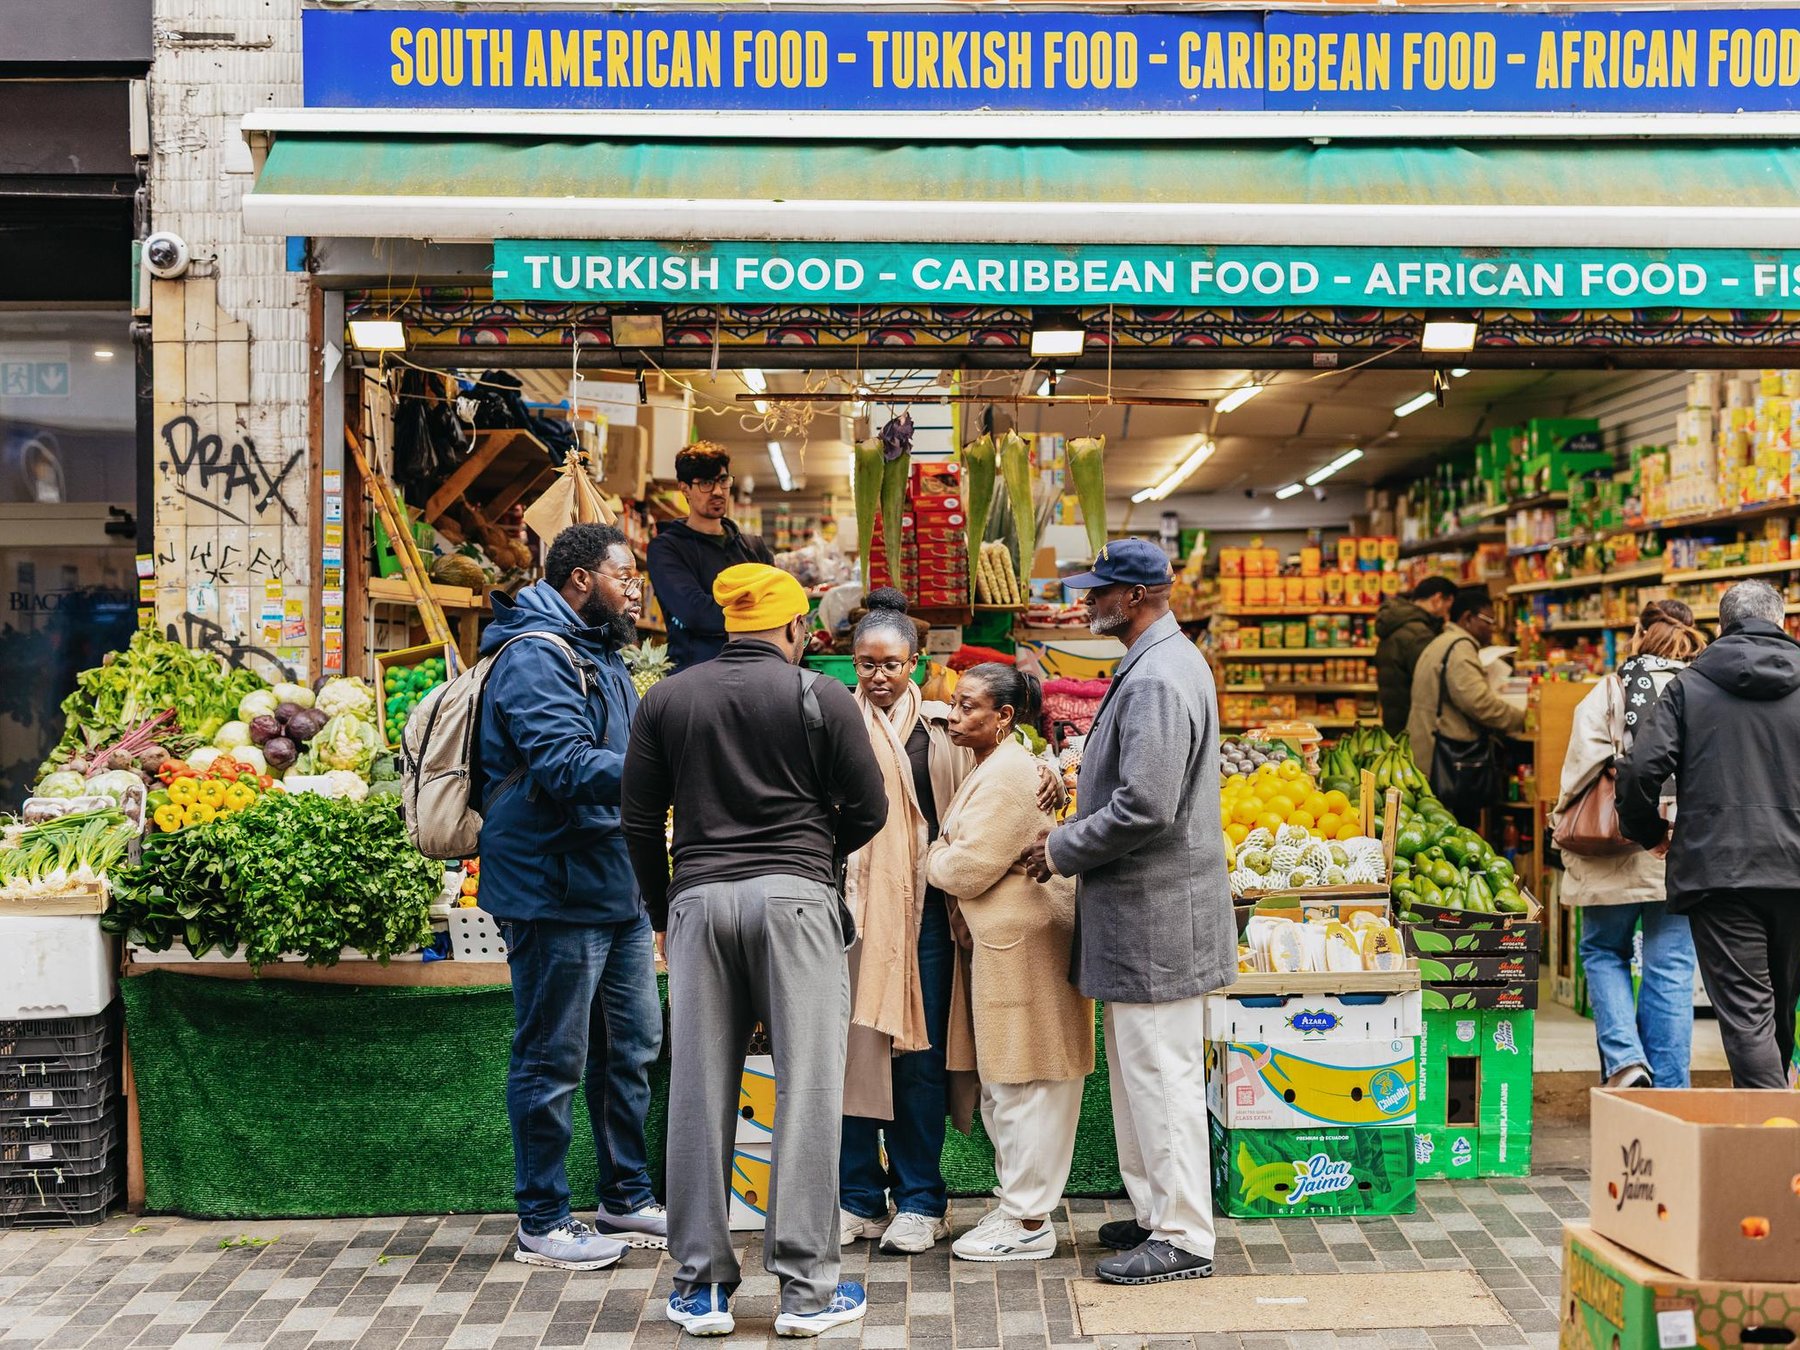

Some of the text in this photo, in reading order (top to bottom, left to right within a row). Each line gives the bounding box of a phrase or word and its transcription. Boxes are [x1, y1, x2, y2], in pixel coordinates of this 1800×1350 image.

[390, 27, 512, 86] SOUTH
[524, 29, 720, 87] AMERICAN
[734, 30, 827, 88] FOOD
[867, 31, 1031, 88] TURKISH
[1044, 31, 1137, 88] FOOD
[1179, 31, 1390, 91] CARIBBEAN
[1402, 32, 1496, 90] FOOD
[1536, 30, 1696, 88] AFRICAN
[1708, 28, 1800, 87] FOOD
[524, 255, 719, 290] TURKISH
[736, 257, 864, 292] FOOD
[912, 259, 1174, 293] CARIBBEAN
[1191, 261, 1319, 295] FOOD
[1364, 262, 1563, 296] AFRICAN
[1582, 262, 1707, 296] FOOD
[162, 415, 304, 525] DRAX
[1494, 1023, 1506, 1042] Don
[1504, 1021, 1518, 1054] Jaime
[1377, 1084, 1410, 1111] Chiquita
[1308, 1155, 1346, 1178] Don
[1421, 1142, 1432, 1160] Don
[1629, 1138, 1654, 1177] Don
[1287, 1174, 1349, 1202] Jaime
[1616, 1172, 1655, 1211] Jaime
